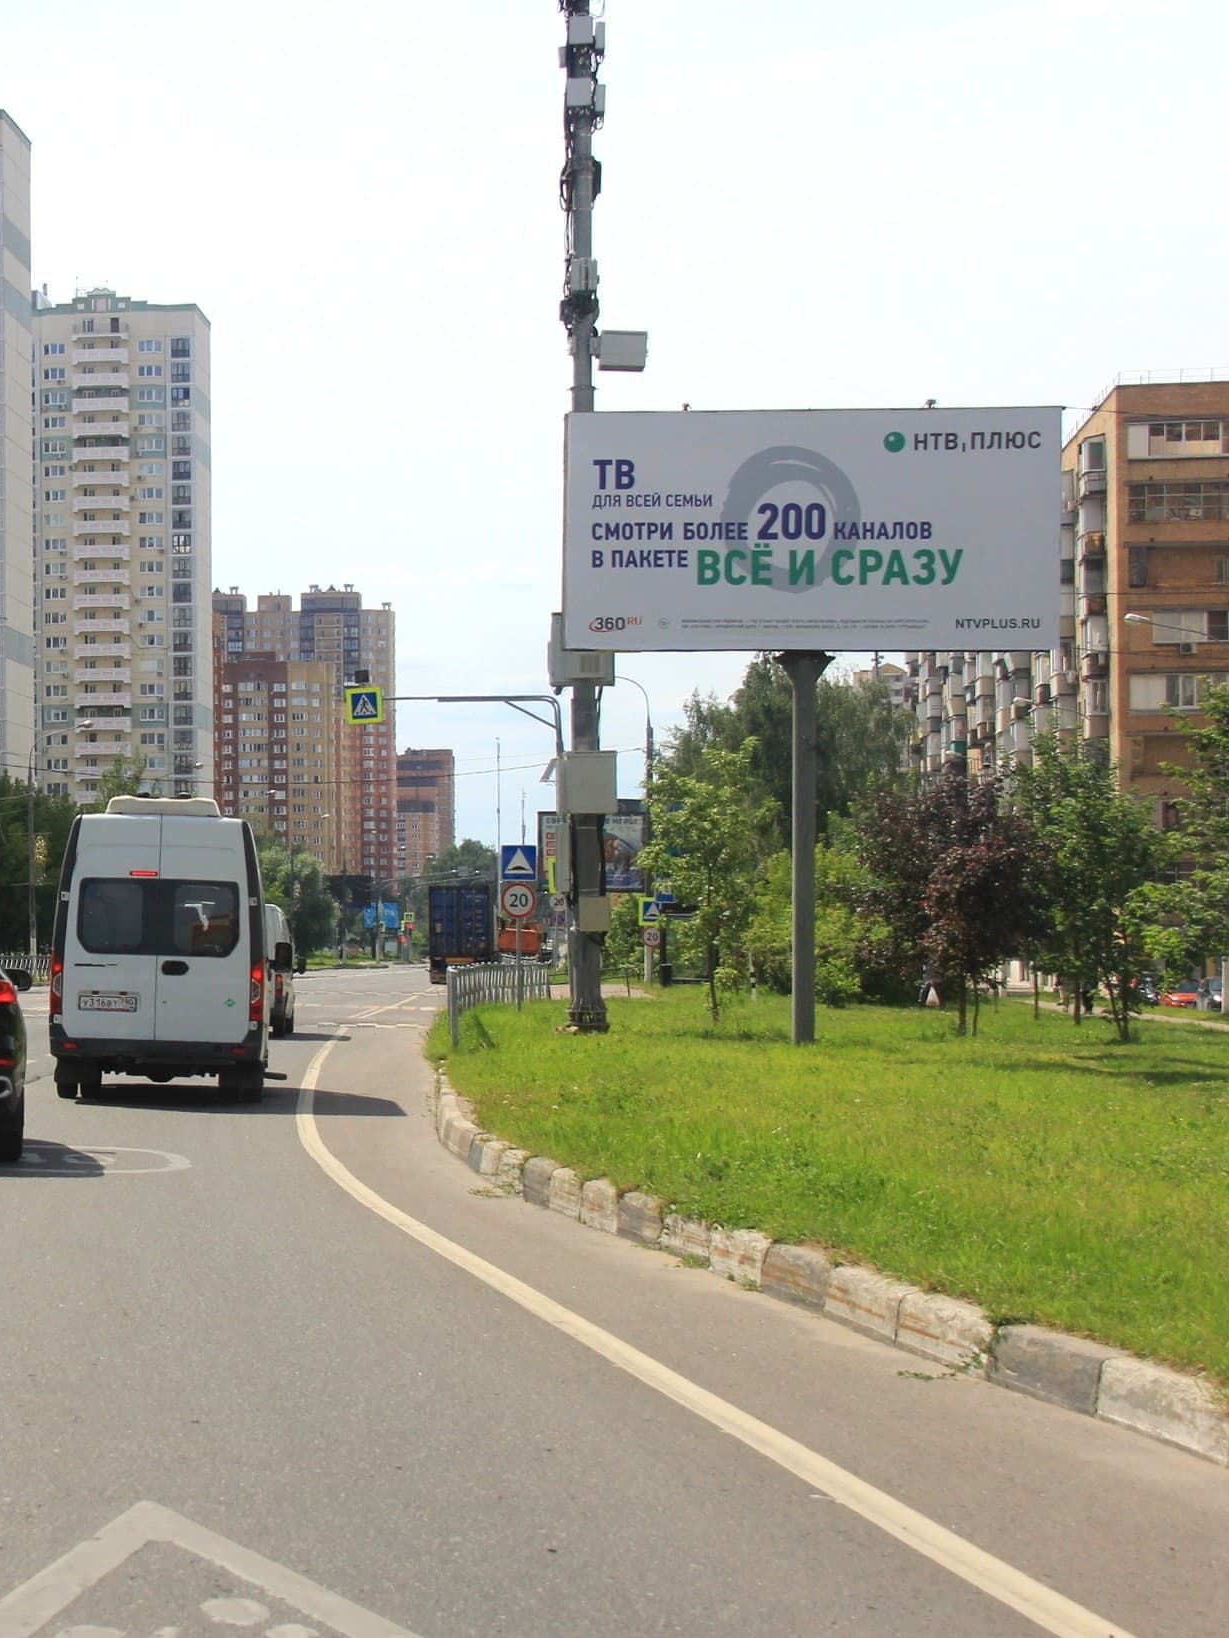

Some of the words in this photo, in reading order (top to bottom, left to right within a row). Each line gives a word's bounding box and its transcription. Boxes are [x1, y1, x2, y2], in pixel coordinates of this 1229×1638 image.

[592, 459, 636, 490] ТВ
[591, 494, 622, 510] ДЛЯ
[625, 493, 661, 508] ВСЕЙ
[665, 493, 713, 508] СЕМЬИ
[591, 521, 673, 541] СМОТРИ
[683, 521, 749, 541] БОЛЕЕ
[756, 502, 827, 541] 200
[834, 521, 932, 541] КАНАЛОВ
[591, 550, 604, 568] В
[611, 550, 689, 568] ПАКЕТЕ
[696, 542, 772, 586] ВСЁ
[788, 551, 815, 585] И
[831, 549, 964, 586] СРАЗУ
[955, 618, 1041, 630] NTVPLUS.RU
[508, 893, 529, 908] 20
[554, 897, 564, 906] 20
[646, 932, 659, 942] 20
